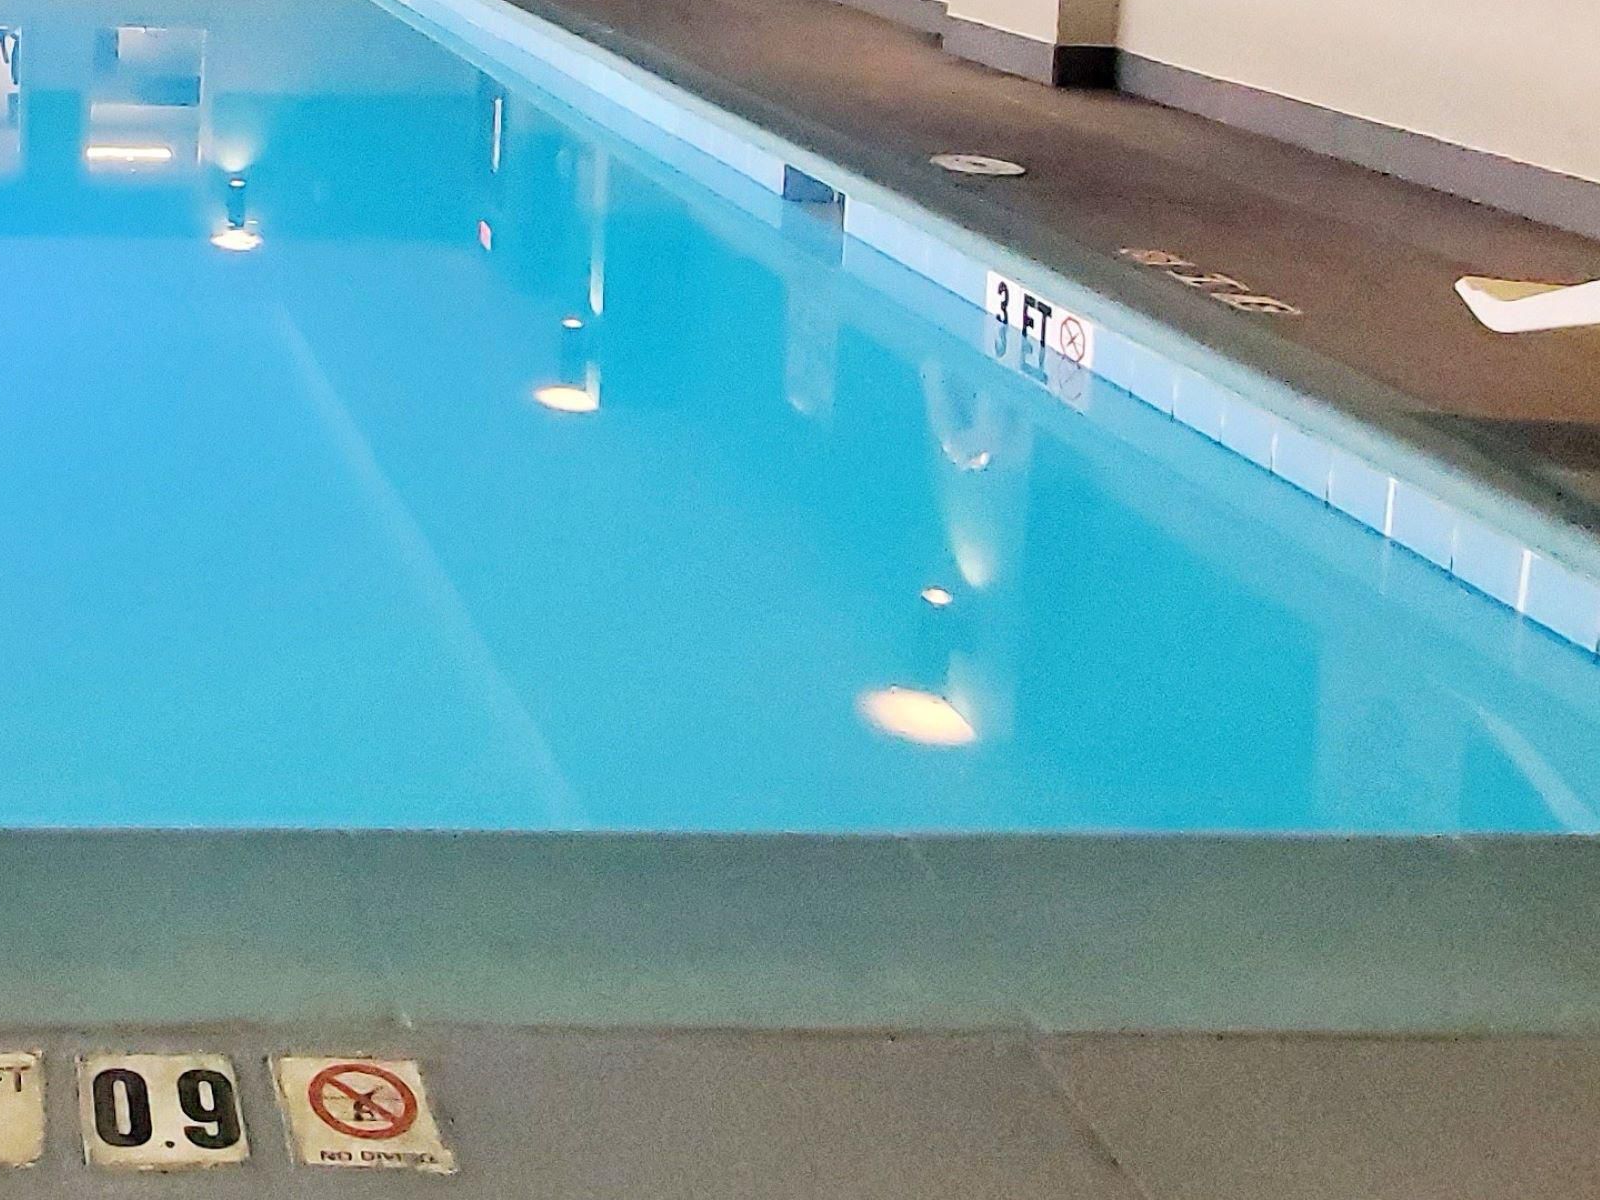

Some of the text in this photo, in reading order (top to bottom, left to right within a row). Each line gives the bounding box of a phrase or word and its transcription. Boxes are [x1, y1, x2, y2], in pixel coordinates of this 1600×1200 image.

[996, 281, 1052, 348] 3 FT
[93, 1068, 241, 1149] 0.9
[320, 1151, 353, 1161] NO
